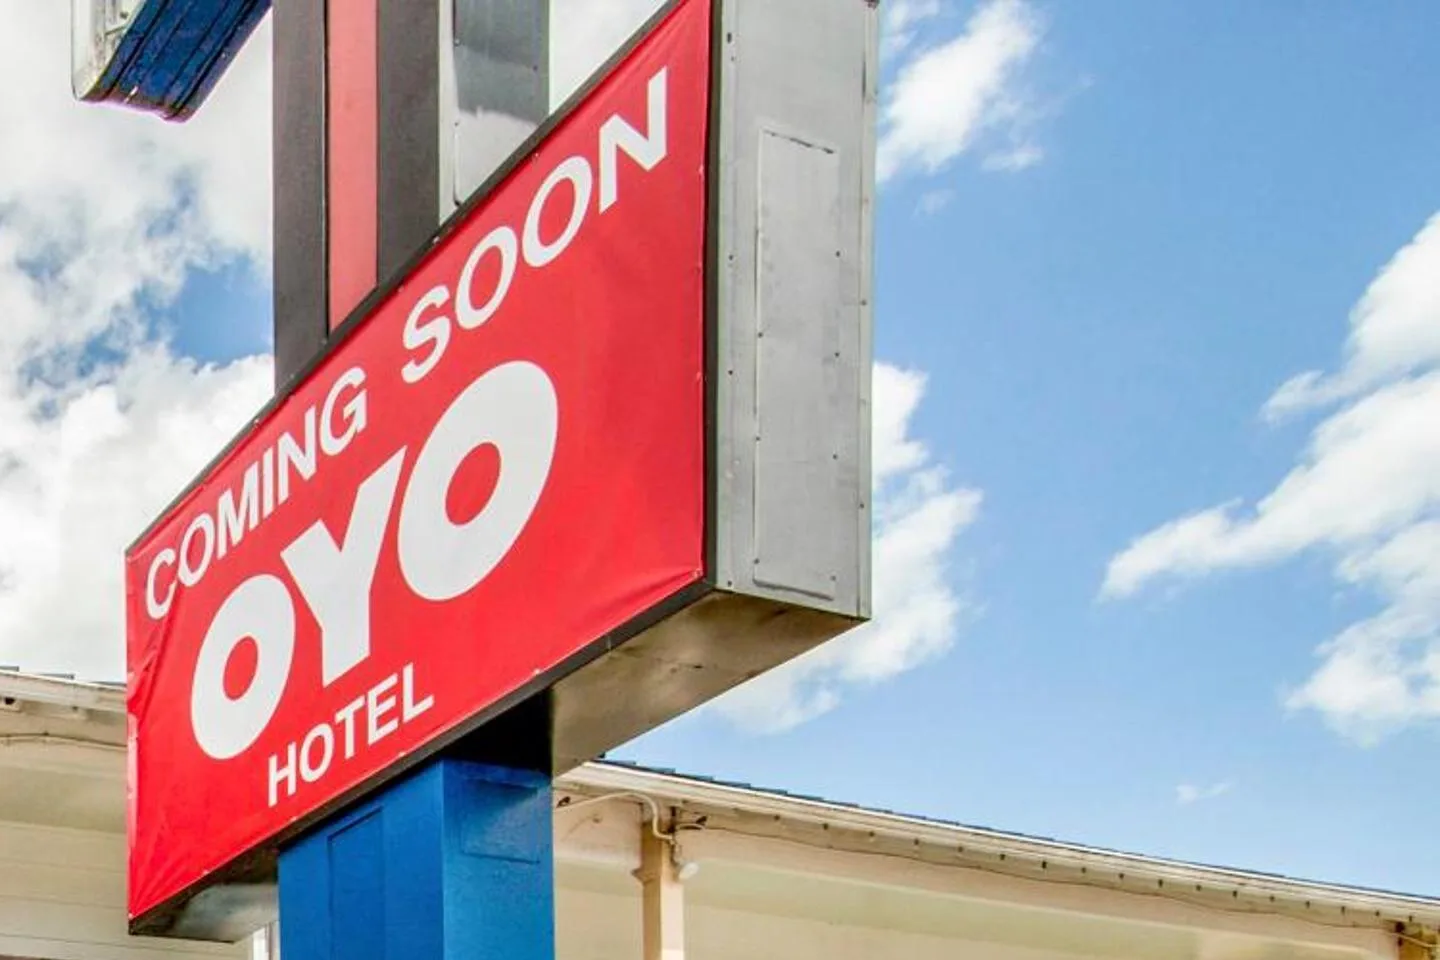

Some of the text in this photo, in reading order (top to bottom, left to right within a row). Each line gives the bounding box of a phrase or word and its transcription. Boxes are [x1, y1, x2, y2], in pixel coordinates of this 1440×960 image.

[145, 66, 667, 620] COMING SOON
[190, 360, 558, 760] OYO
[268, 663, 434, 807] HOTEL
